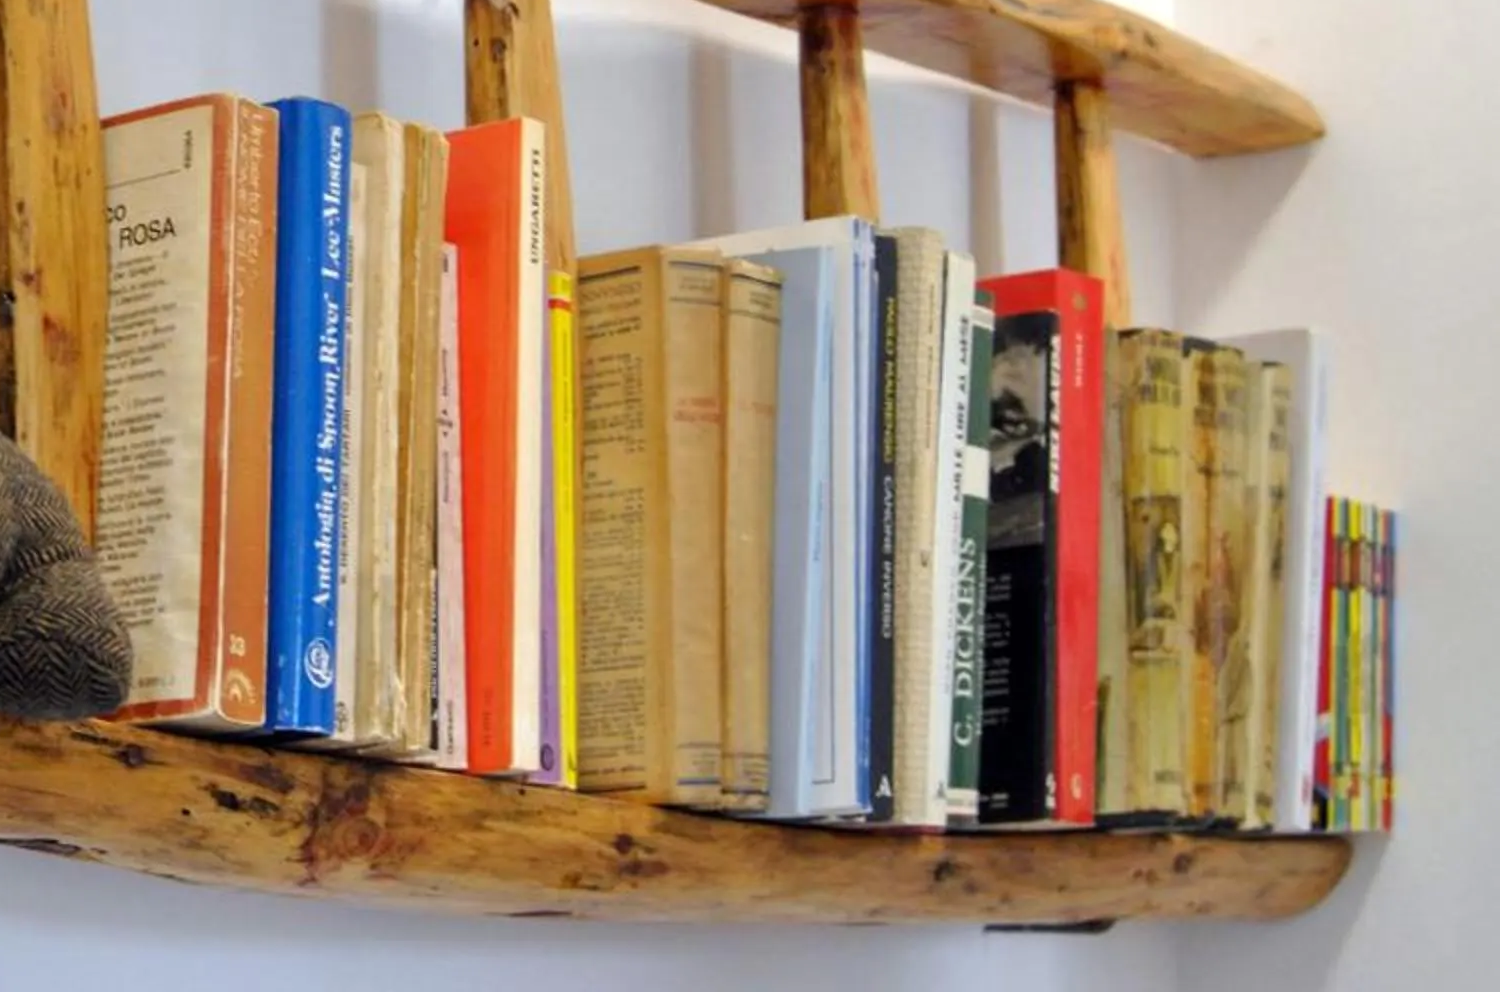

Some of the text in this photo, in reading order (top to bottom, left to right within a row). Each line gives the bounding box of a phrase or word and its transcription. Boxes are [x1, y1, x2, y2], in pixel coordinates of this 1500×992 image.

[119, 216, 177, 249] ROSA
[321, 124, 345, 280] Lee Masters
[312, 292, 341, 607] Antologia di Spoon River
[883, 474, 894, 555] CANONE
[953, 536, 976, 747] C. DICKENS
